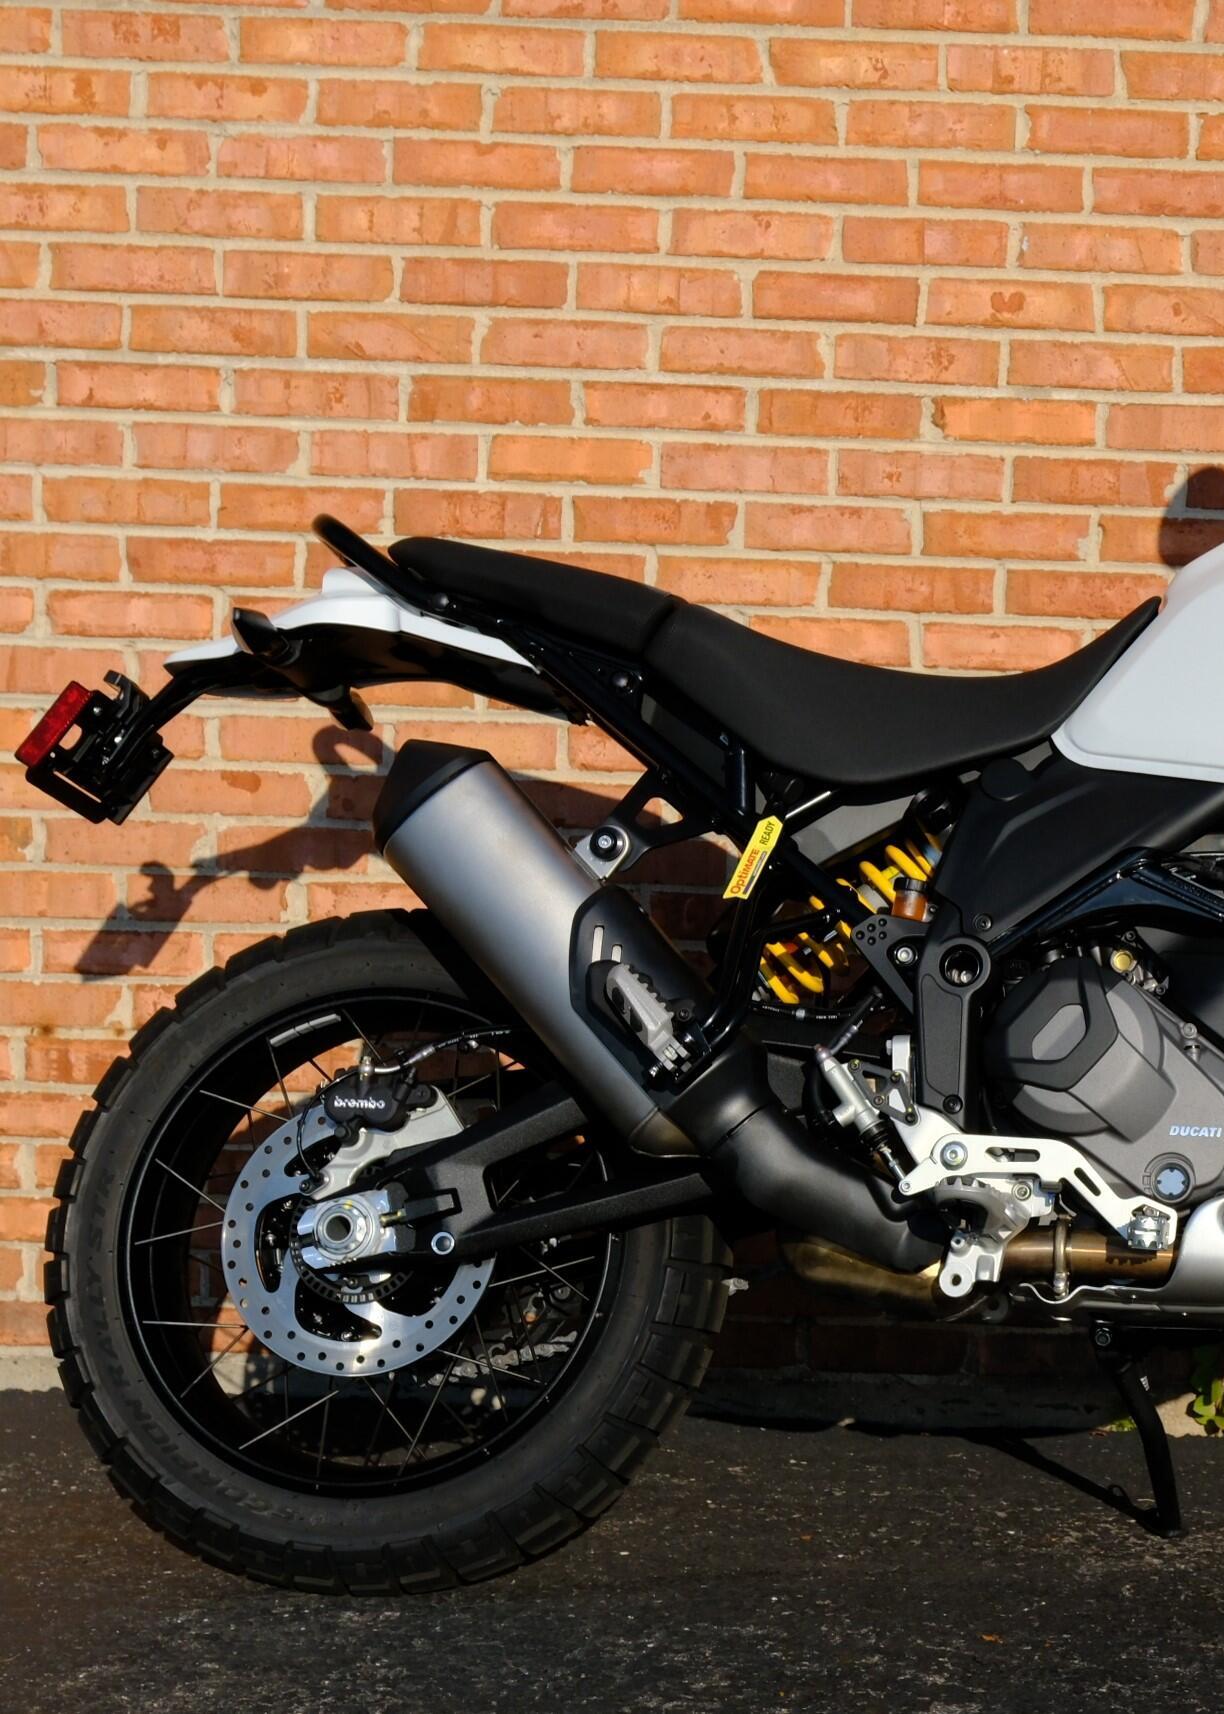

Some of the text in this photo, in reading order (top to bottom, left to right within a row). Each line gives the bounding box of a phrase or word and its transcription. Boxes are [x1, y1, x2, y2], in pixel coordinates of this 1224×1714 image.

[760, 820, 776, 846] READY
[334, 1095, 386, 1109] brembo
[1169, 1125, 1223, 1138] DUCATI
[86, 1258, 132, 1388] RALLY
